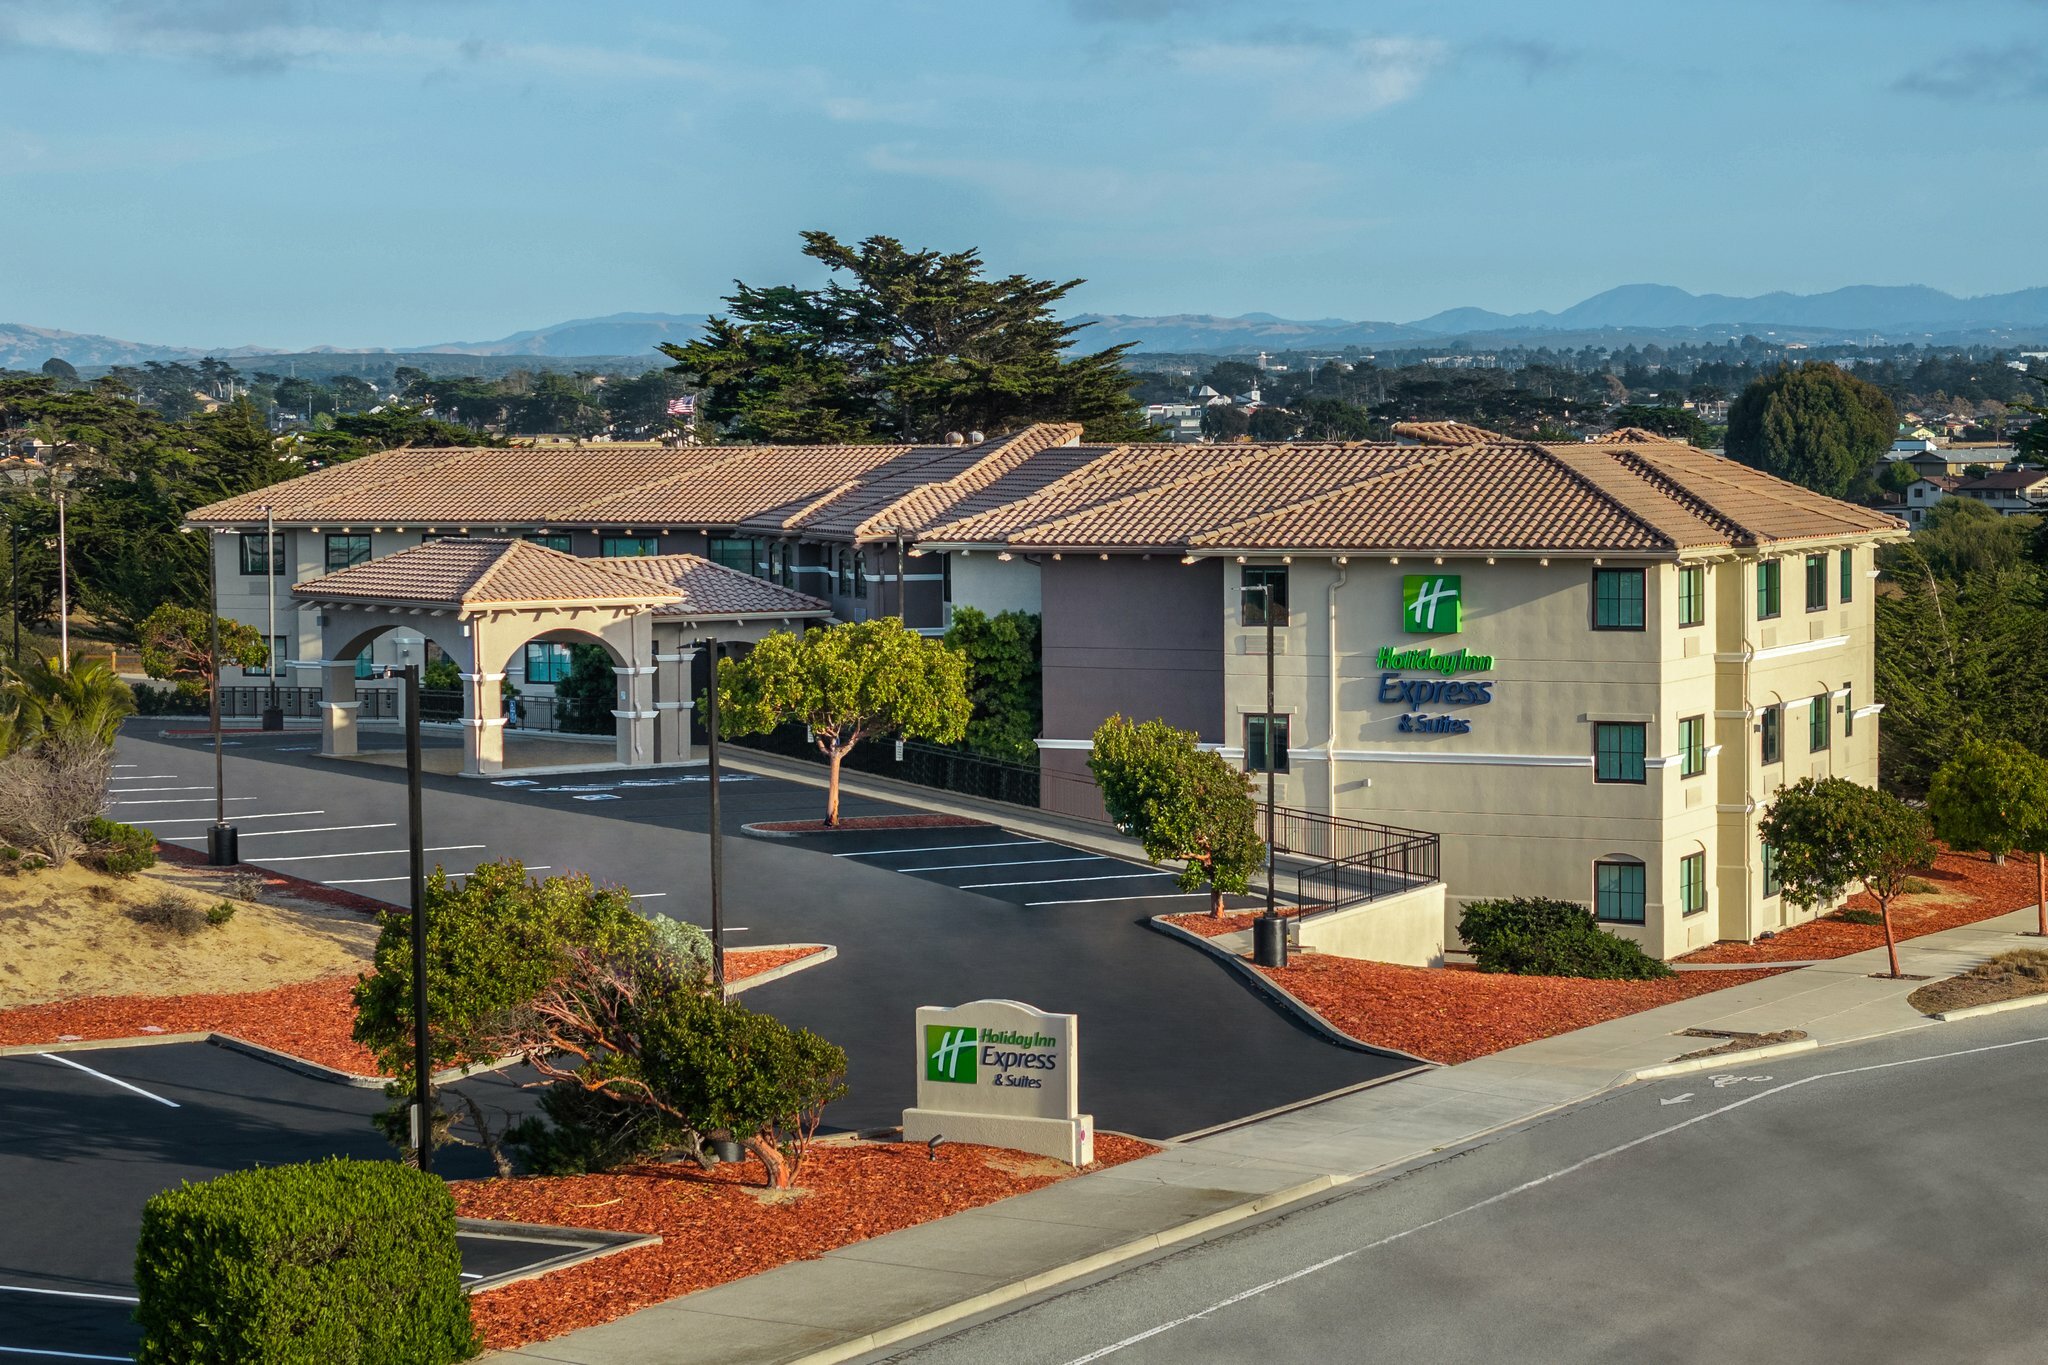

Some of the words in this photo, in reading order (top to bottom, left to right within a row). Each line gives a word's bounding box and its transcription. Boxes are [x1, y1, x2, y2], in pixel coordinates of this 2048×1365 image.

[1408, 578, 1458, 629] H
[1376, 645, 1457, 676] Holiday
[1459, 647, 1495, 671] Inn
[1378, 673, 1494, 712] Express
[1398, 713, 1413, 734] &
[1415, 714, 1473, 734] Suites
[980, 1028, 1034, 1049] Holiday
[1034, 1032, 1057, 1048] Inn
[931, 1029, 978, 1078] H
[981, 1046, 1057, 1072] Express
[994, 1073, 1004, 1087] &
[1005, 1074, 1042, 1089] Suites
